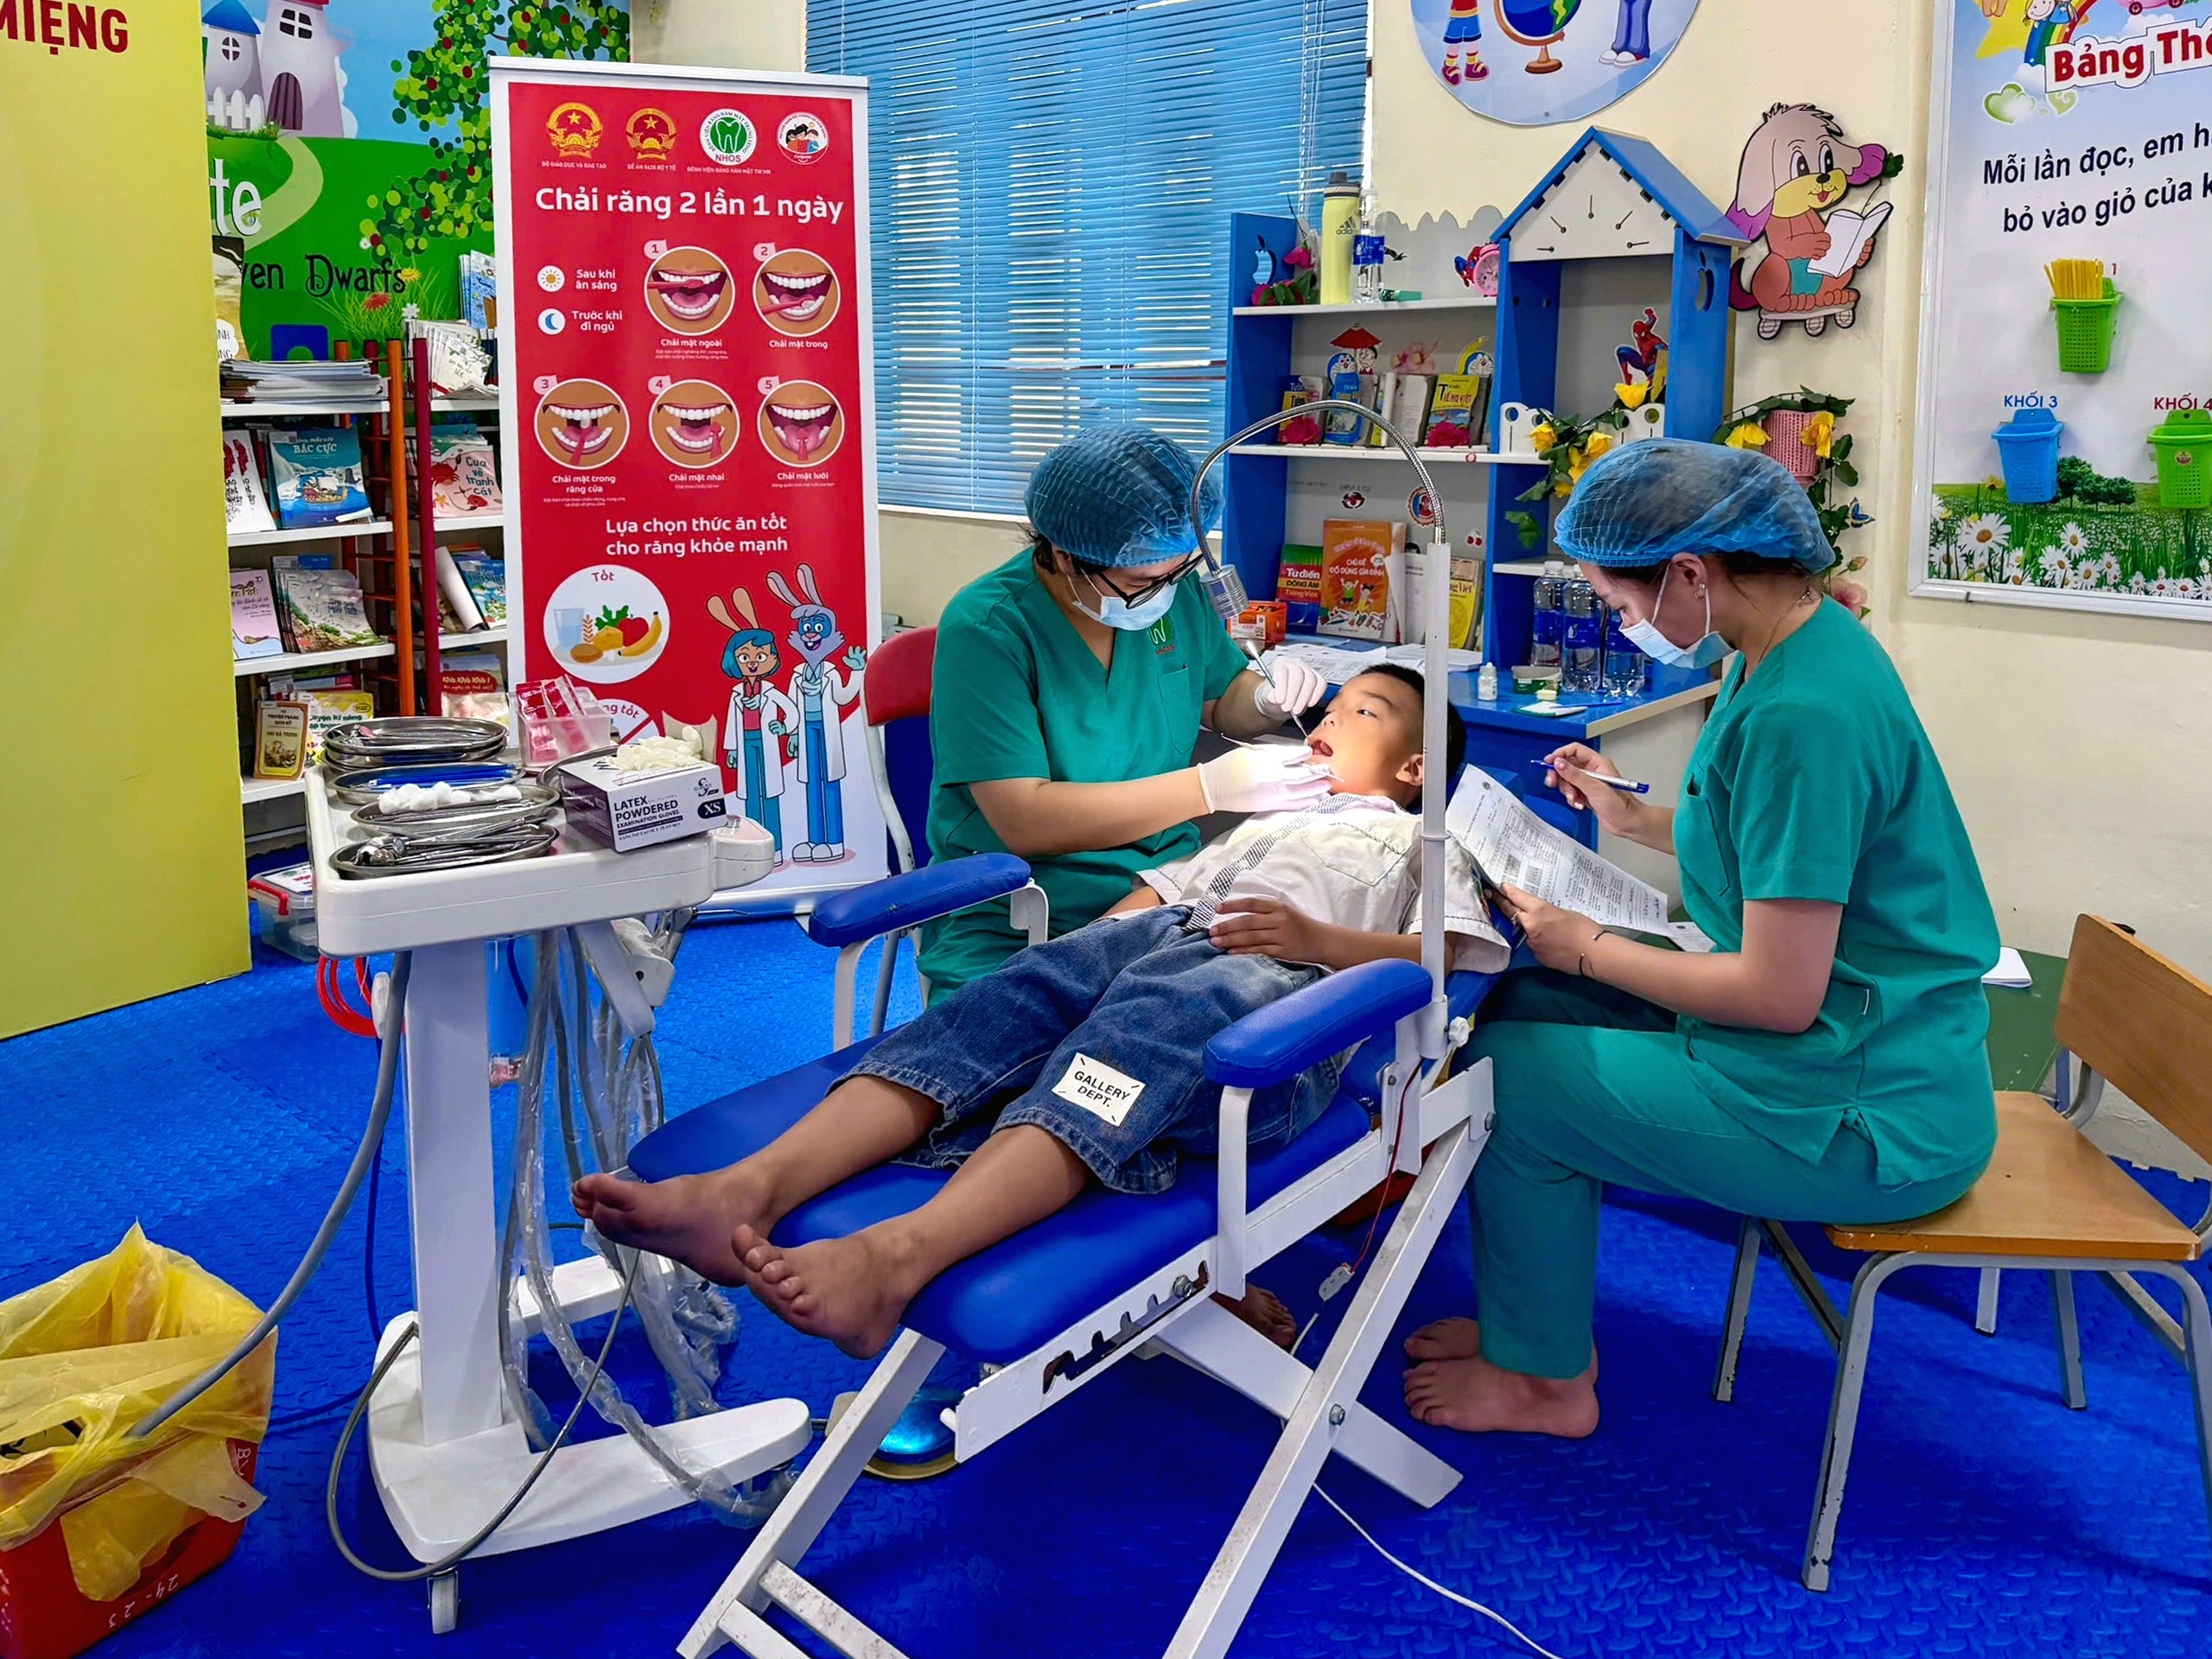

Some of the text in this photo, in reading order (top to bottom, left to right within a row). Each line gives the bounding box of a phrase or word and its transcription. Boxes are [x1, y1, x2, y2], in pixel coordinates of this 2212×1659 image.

[2054, 29, 2212, 83] Bảng Th
[715, 154, 741, 162] NHOS
[1983, 153, 2025, 185] Mỗi
[2034, 149, 2070, 181] lần
[2080, 147, 2134, 176] đọc,
[2144, 132, 2183, 159] em
[535, 188, 844, 225] Chải răng 2 lần 1 ngày
[2003, 206, 2034, 232] bỏ
[2042, 200, 2086, 229] vào
[2094, 188, 2136, 226] giỏ
[2145, 177, 2192, 208] của
[652, 244, 659, 253] 1
[760, 246, 768, 256] 2
[305, 253, 406, 298] Dwarfs
[576, 268, 615, 280] Sau khi
[575, 279, 618, 293] ăn sáng
[605, 310, 623, 321] khi
[580, 321, 615, 334] đi ngủ
[660, 338, 680, 346] Chải
[769, 339, 787, 347] Chải
[805, 340, 828, 350] trong
[541, 379, 549, 389] 3
[655, 380, 663, 389] 4
[765, 380, 772, 389] 5
[2004, 391, 2057, 408] KHỐI 3
[2154, 392, 2197, 410] KHỐI
[467, 456, 486, 467] Cua
[552, 474, 571, 483] Chải
[591, 476, 616, 485] trong
[669, 473, 688, 482] Chải
[777, 472, 795, 480] Chải
[566, 486, 586, 495] răng
[607, 512, 787, 537] Lựa chọn thức ăn tốt
[607, 535, 788, 558] cho răng khỏe mạnh
[613, 795, 648, 811] LATEX
[704, 801, 721, 816] XS
[615, 799, 678, 823] POWDERED
[616, 815, 657, 830] EXAMINATION
[658, 809, 680, 819] GLOVES
[1074, 1071, 1130, 1101] GALLERY
[1077, 1085, 1110, 1108] DEPT.
